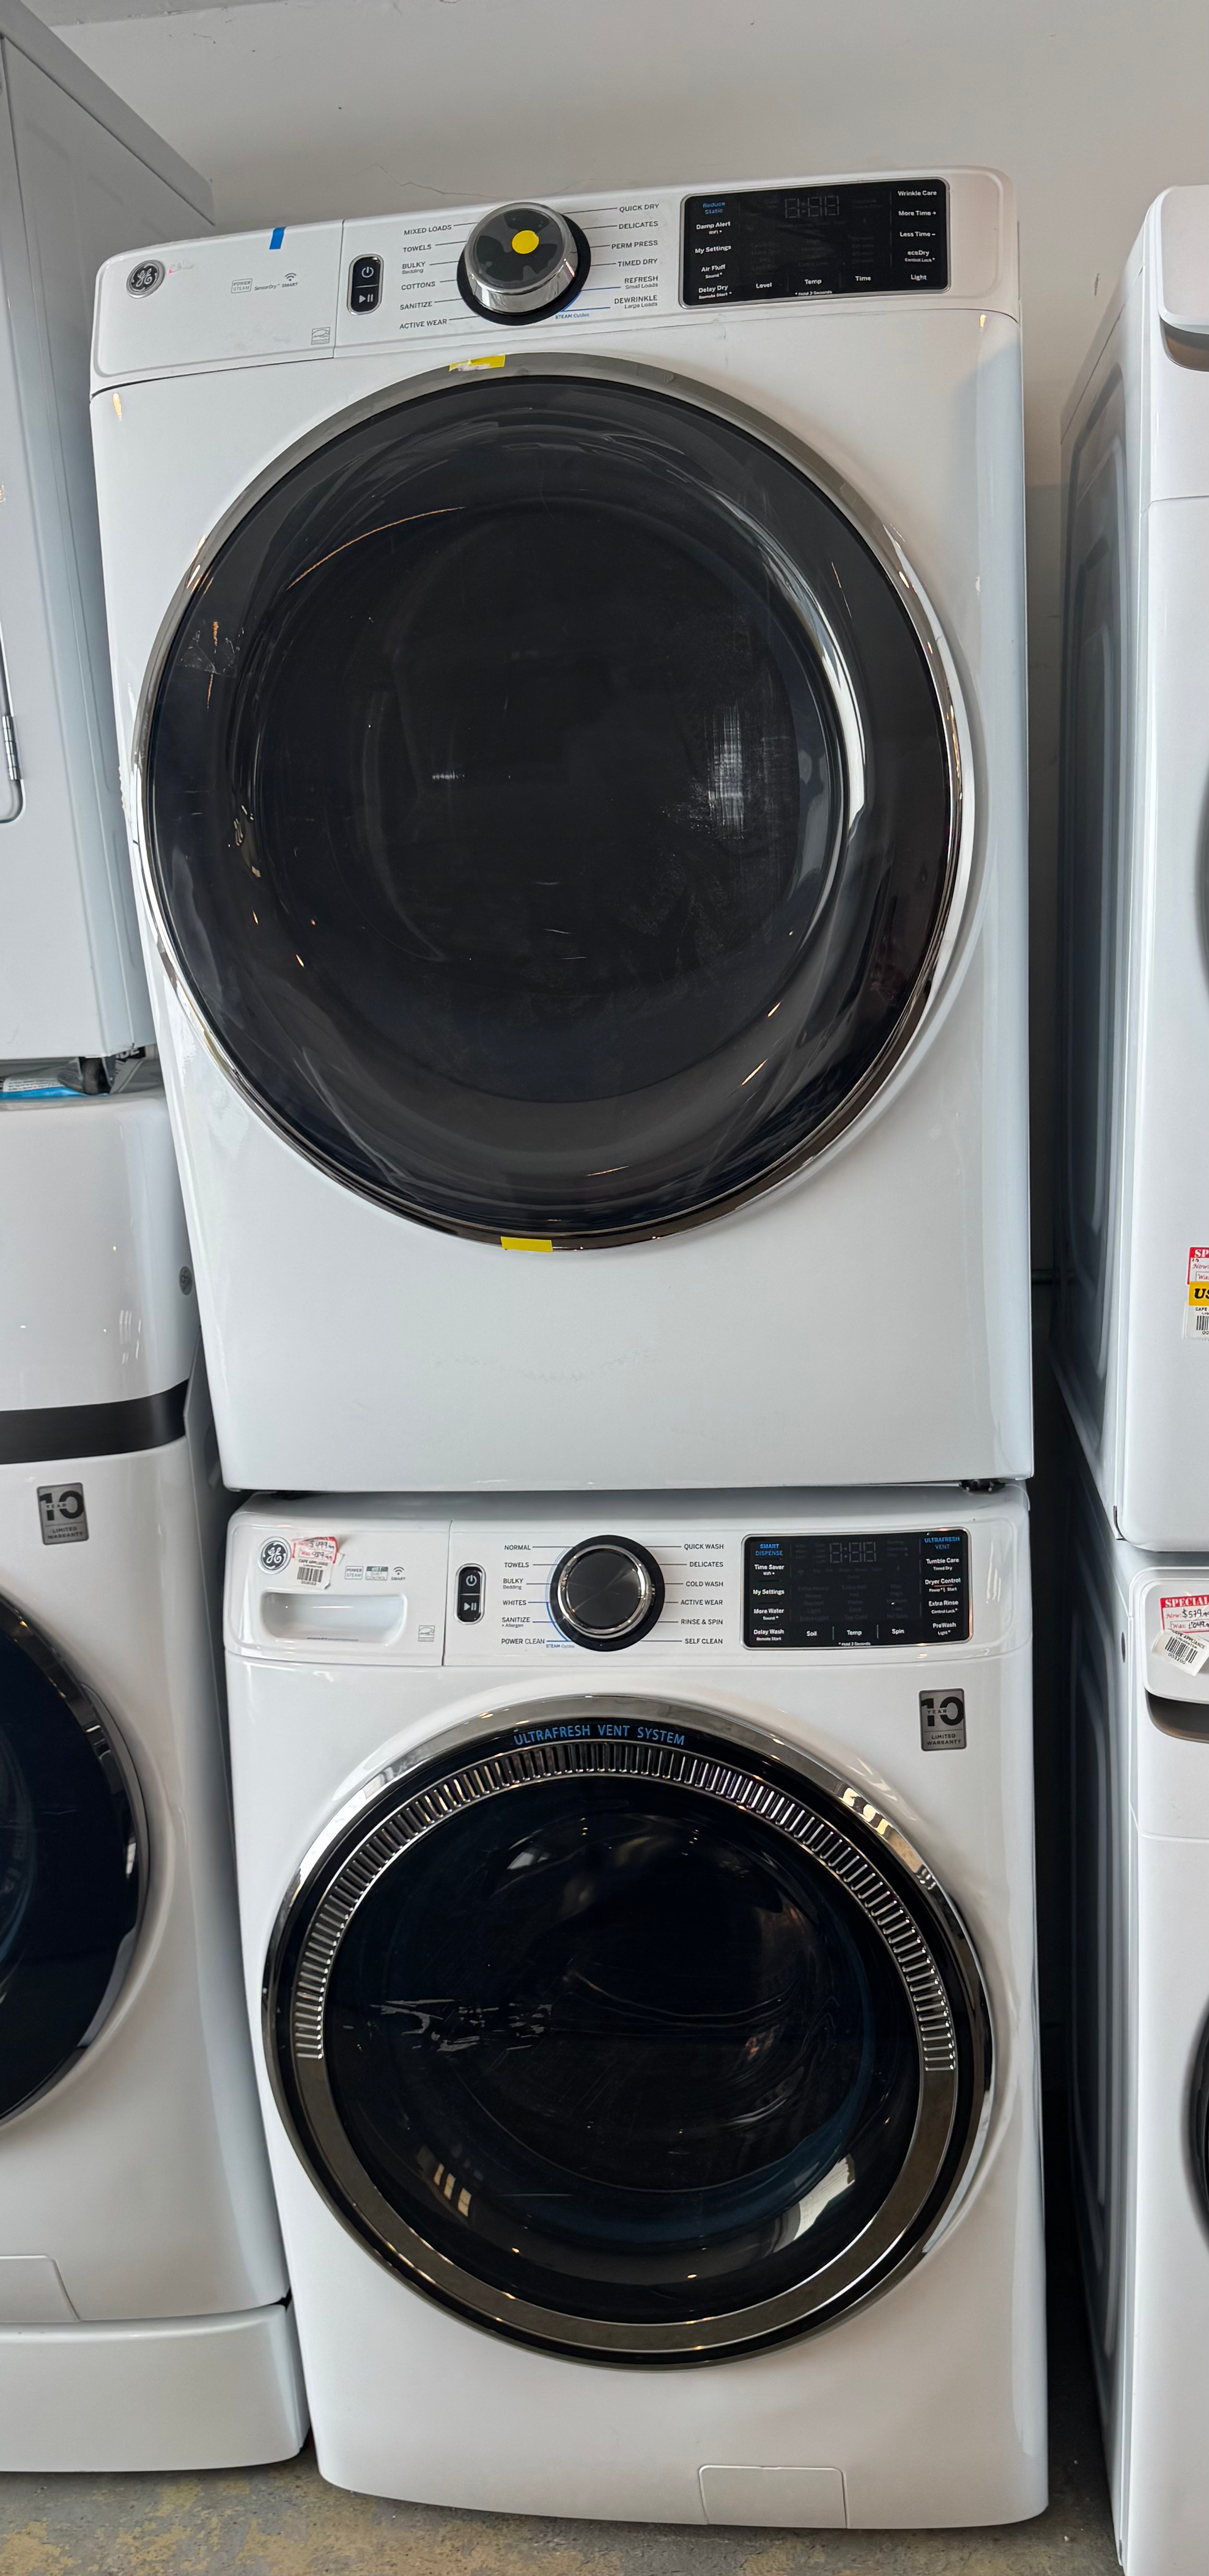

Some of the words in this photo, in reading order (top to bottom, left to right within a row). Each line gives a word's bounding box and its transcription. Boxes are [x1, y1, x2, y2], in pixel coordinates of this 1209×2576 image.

[619, 205, 643, 213] QUICK
[619, 221, 658, 229] DELICATES
[403, 244, 432, 253] TOWELS
[402, 261, 426, 270] BULKY
[625, 275, 658, 284] REFRESH
[401, 281, 436, 290] COTTONS
[614, 295, 658, 304] DEWRINKLE
[400, 301, 432, 310] SANITIZE
[399, 321, 425, 329] ACTIVE
[40, 1490, 84, 1521] 10
[921, 1696, 964, 1727] 10
[514, 1725, 590, 1746] ULTRAFRESH
[597, 1725, 630, 1737] VENT
[637, 1727, 685, 1746] SYSTEM
